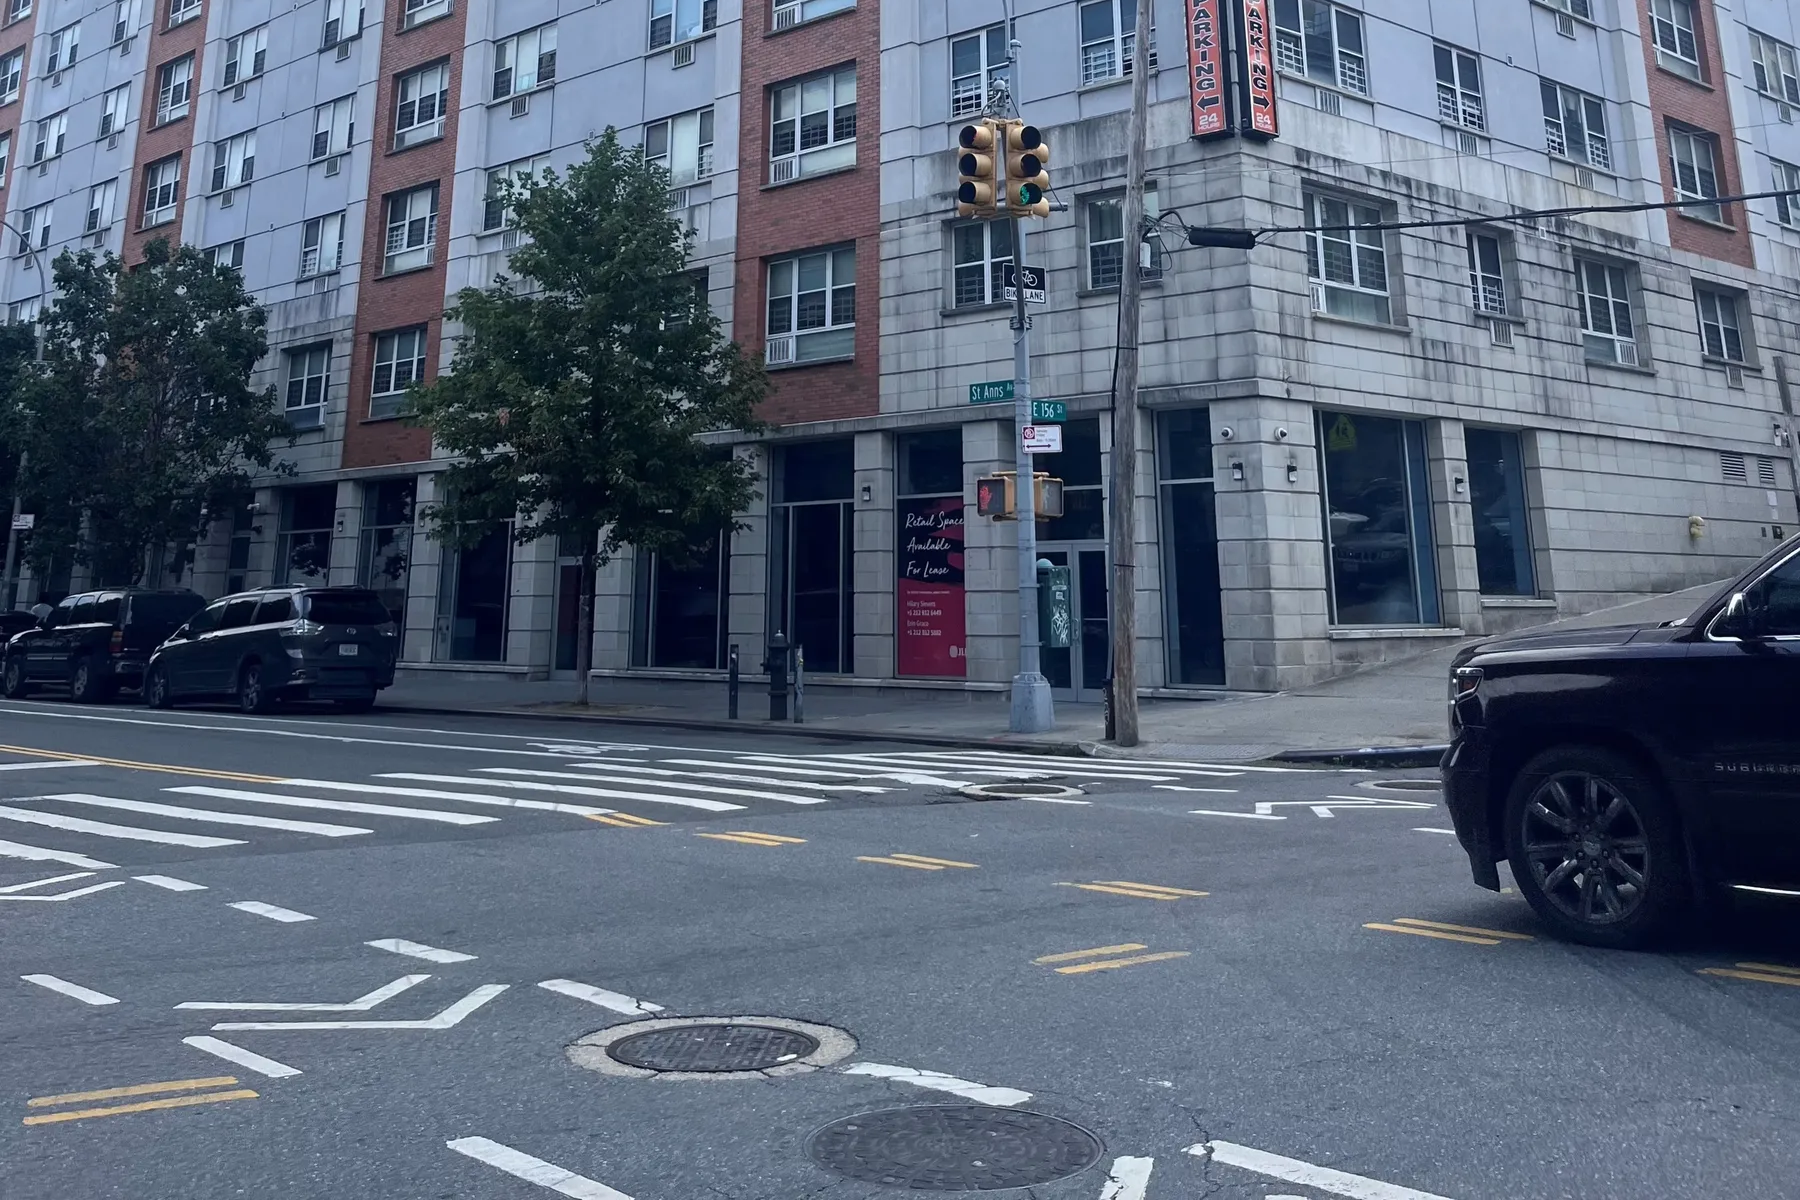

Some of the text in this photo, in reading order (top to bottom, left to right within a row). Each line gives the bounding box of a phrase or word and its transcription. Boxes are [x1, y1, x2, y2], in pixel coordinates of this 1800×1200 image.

[1198, 121, 1220, 131] HOURS
[1199, 112, 1218, 126] 24
[1255, 121, 1273, 131] HOURS
[1256, 112, 1271, 125] 24
[1006, 288, 1043, 301] BIK LANE
[972, 382, 1015, 400] St Anns Av
[1033, 402, 1063, 418] E 156 St
[905, 510, 964, 530] Retail Space
[906, 536, 951, 553] Available
[906, 560, 949, 577] For Lease
